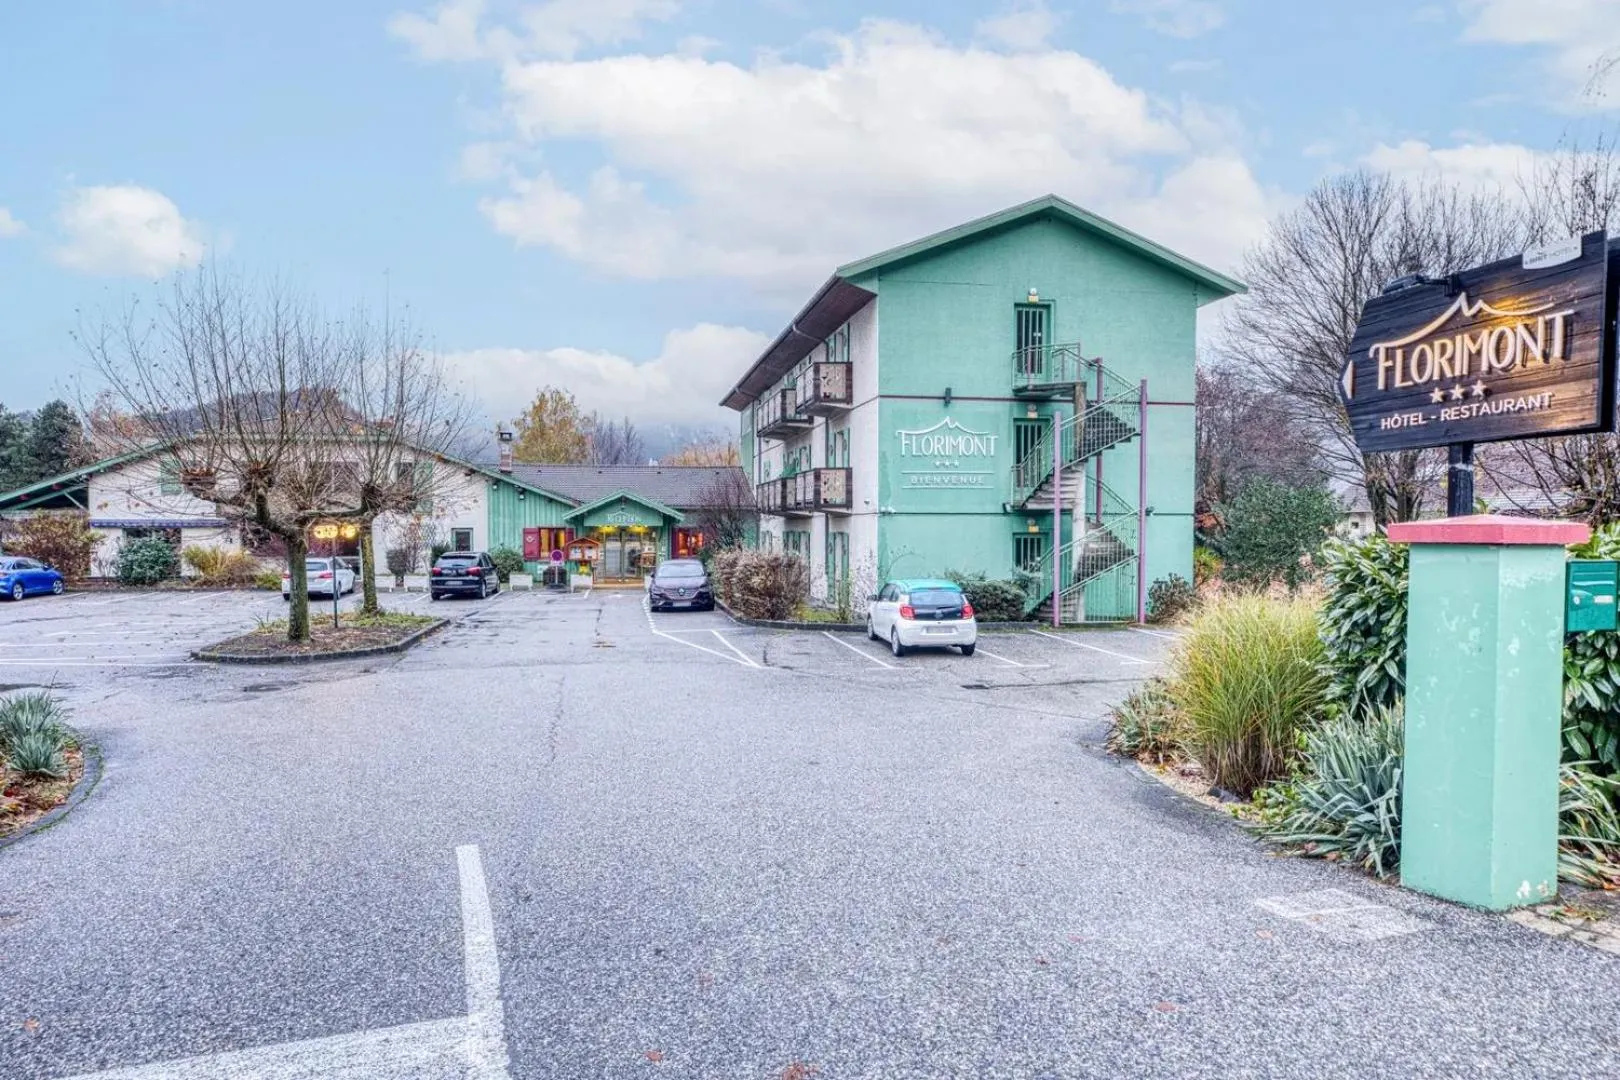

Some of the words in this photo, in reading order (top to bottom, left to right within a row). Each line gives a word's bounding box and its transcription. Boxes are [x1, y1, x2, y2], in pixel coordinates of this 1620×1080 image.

[1369, 309, 1575, 391] FLORIMONT
[1381, 412, 1427, 430] HÔTEL
[1440, 391, 1553, 422] RESTAURANT
[896, 429, 999, 457] FLORIMONT
[910, 475, 985, 485] BIENVENUE
